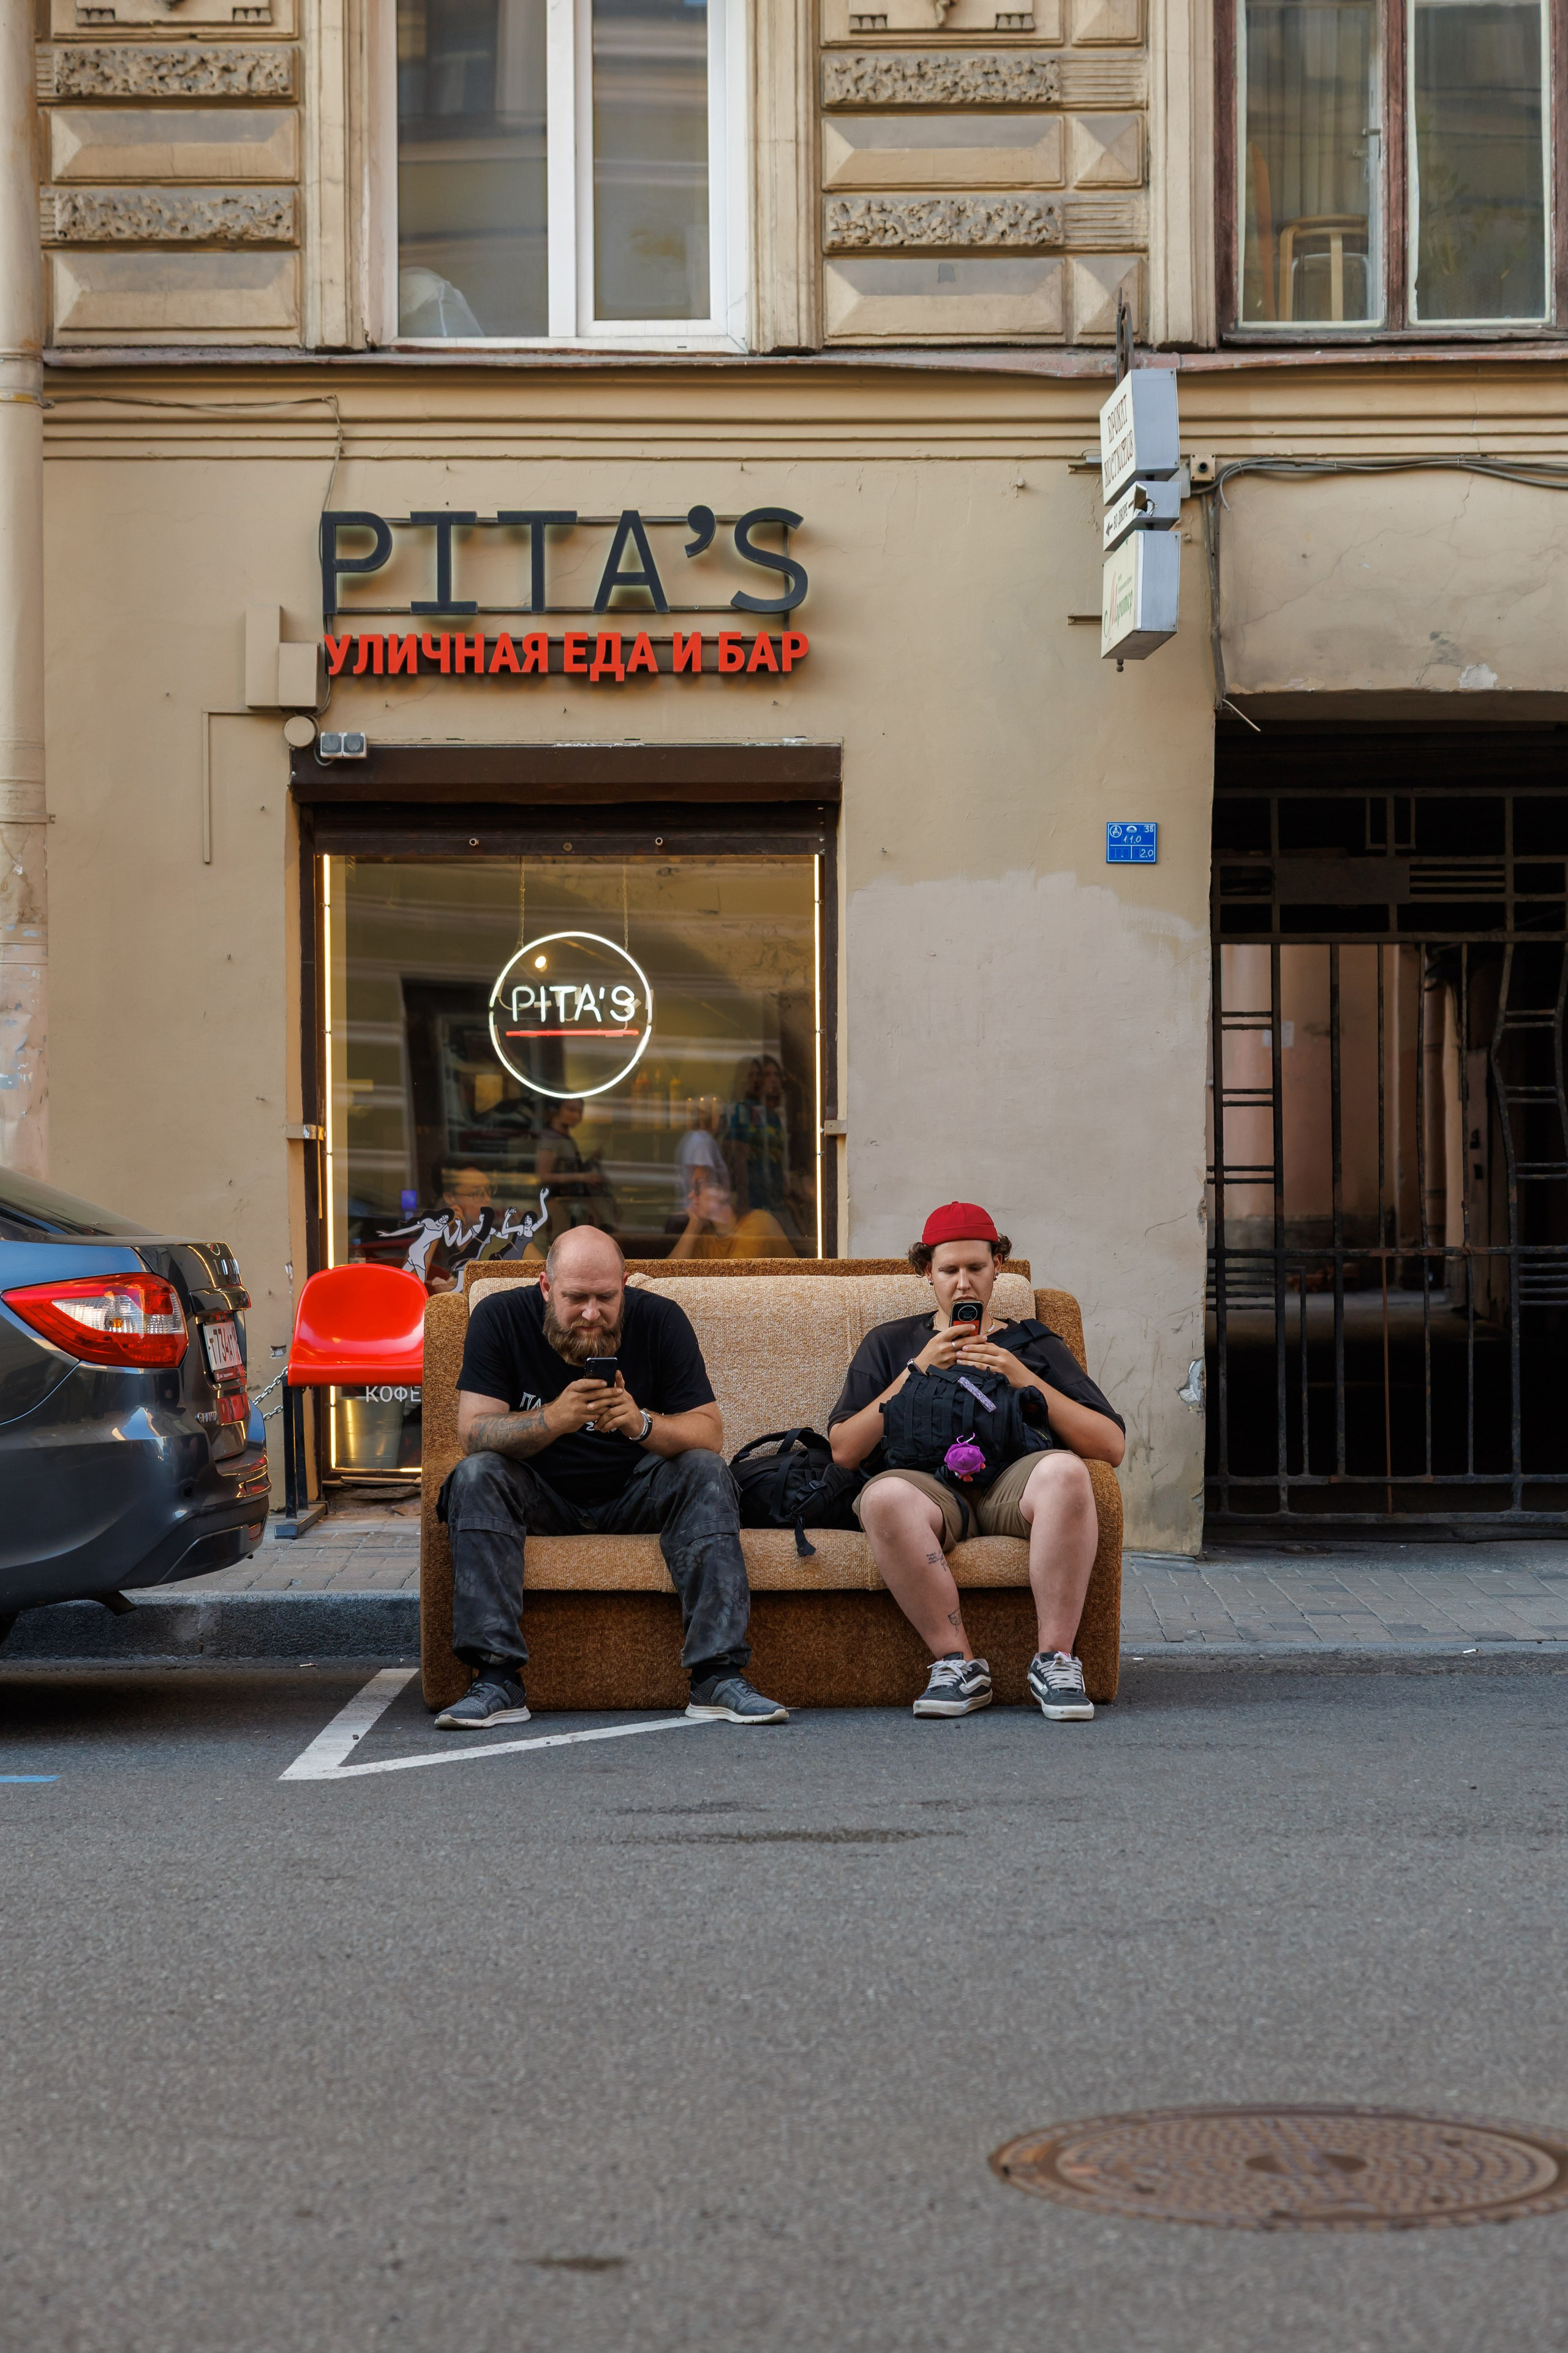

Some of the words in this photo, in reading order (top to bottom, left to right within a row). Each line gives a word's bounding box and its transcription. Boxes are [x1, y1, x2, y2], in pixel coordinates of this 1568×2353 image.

[323, 632, 549, 675] УЛИЧНАЯ
[563, 632, 658, 682] ЕДА
[672, 632, 703, 673] И
[717, 631, 810, 672] БАР
[512, 983, 635, 1022] PITA'S
[366, 1386, 421, 1402] КОФЕ
